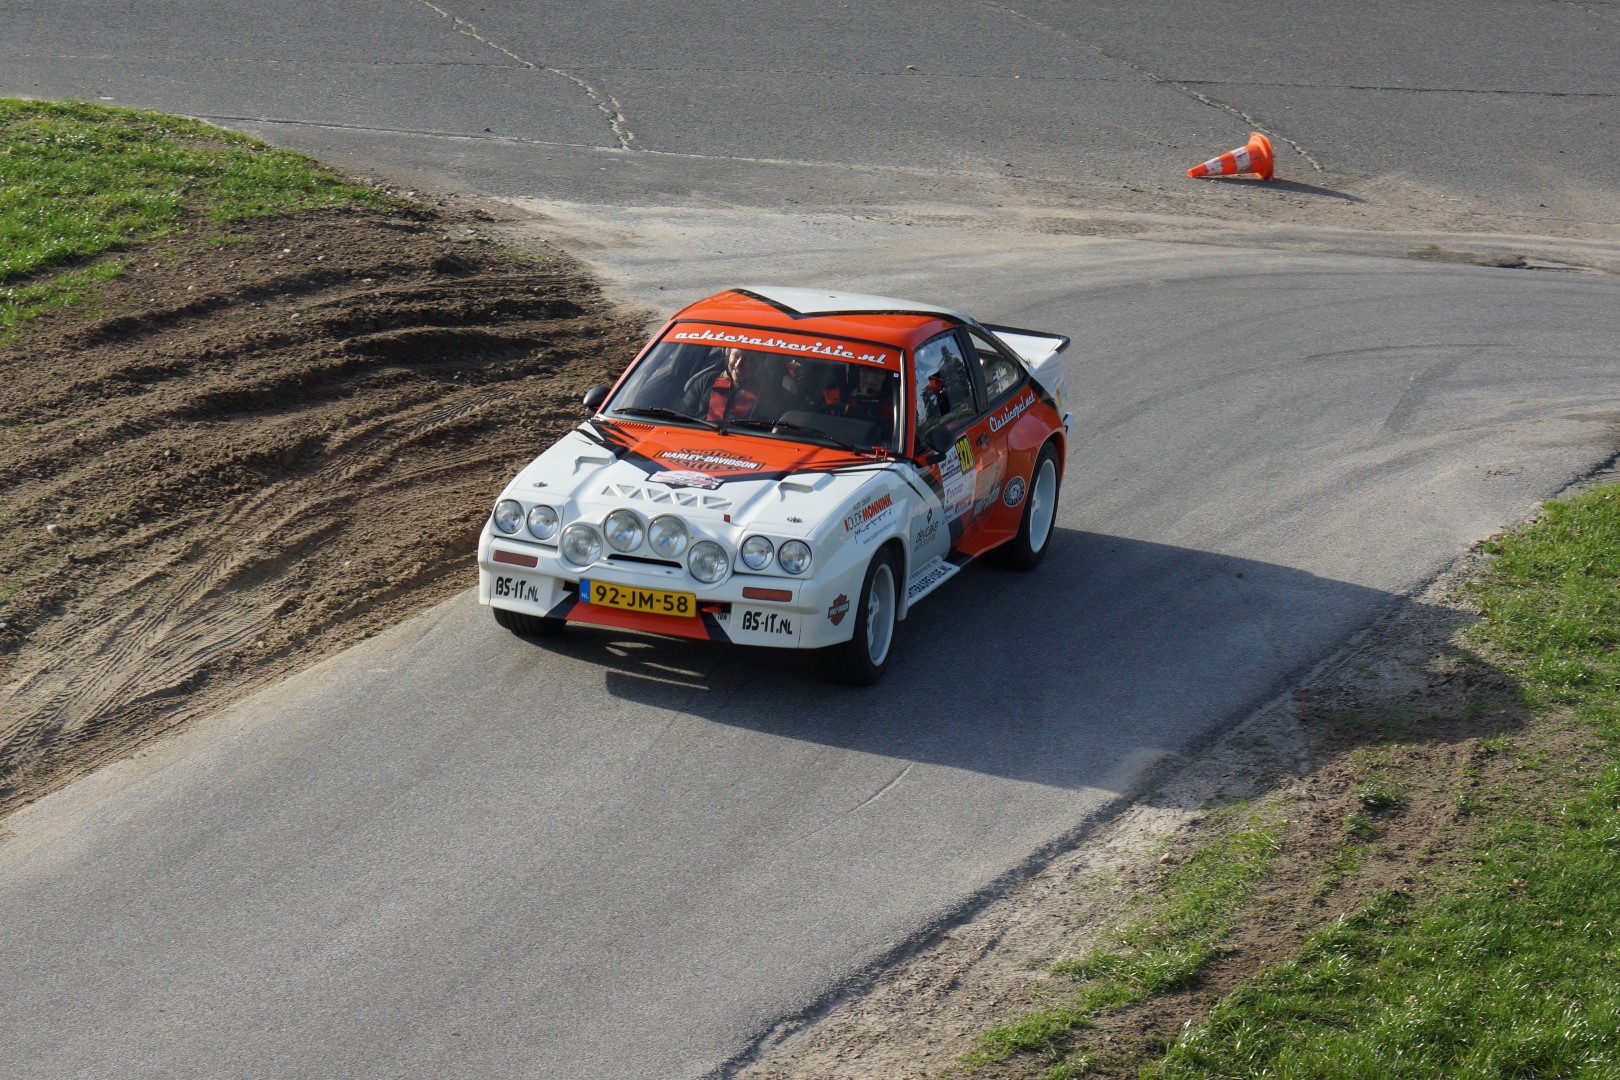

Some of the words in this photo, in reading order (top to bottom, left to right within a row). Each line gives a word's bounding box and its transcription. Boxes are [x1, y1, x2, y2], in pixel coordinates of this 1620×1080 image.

[674, 330, 887, 365] achterasrevisie.nl
[661, 451, 758, 469] HARLEY-DAVIDSON
[495, 576, 539, 602] BS-IT.NL
[581, 592, 589, 600] NL
[595, 585, 688, 613] 92-JM-58
[742, 610, 793, 635] BS-IT.NL
